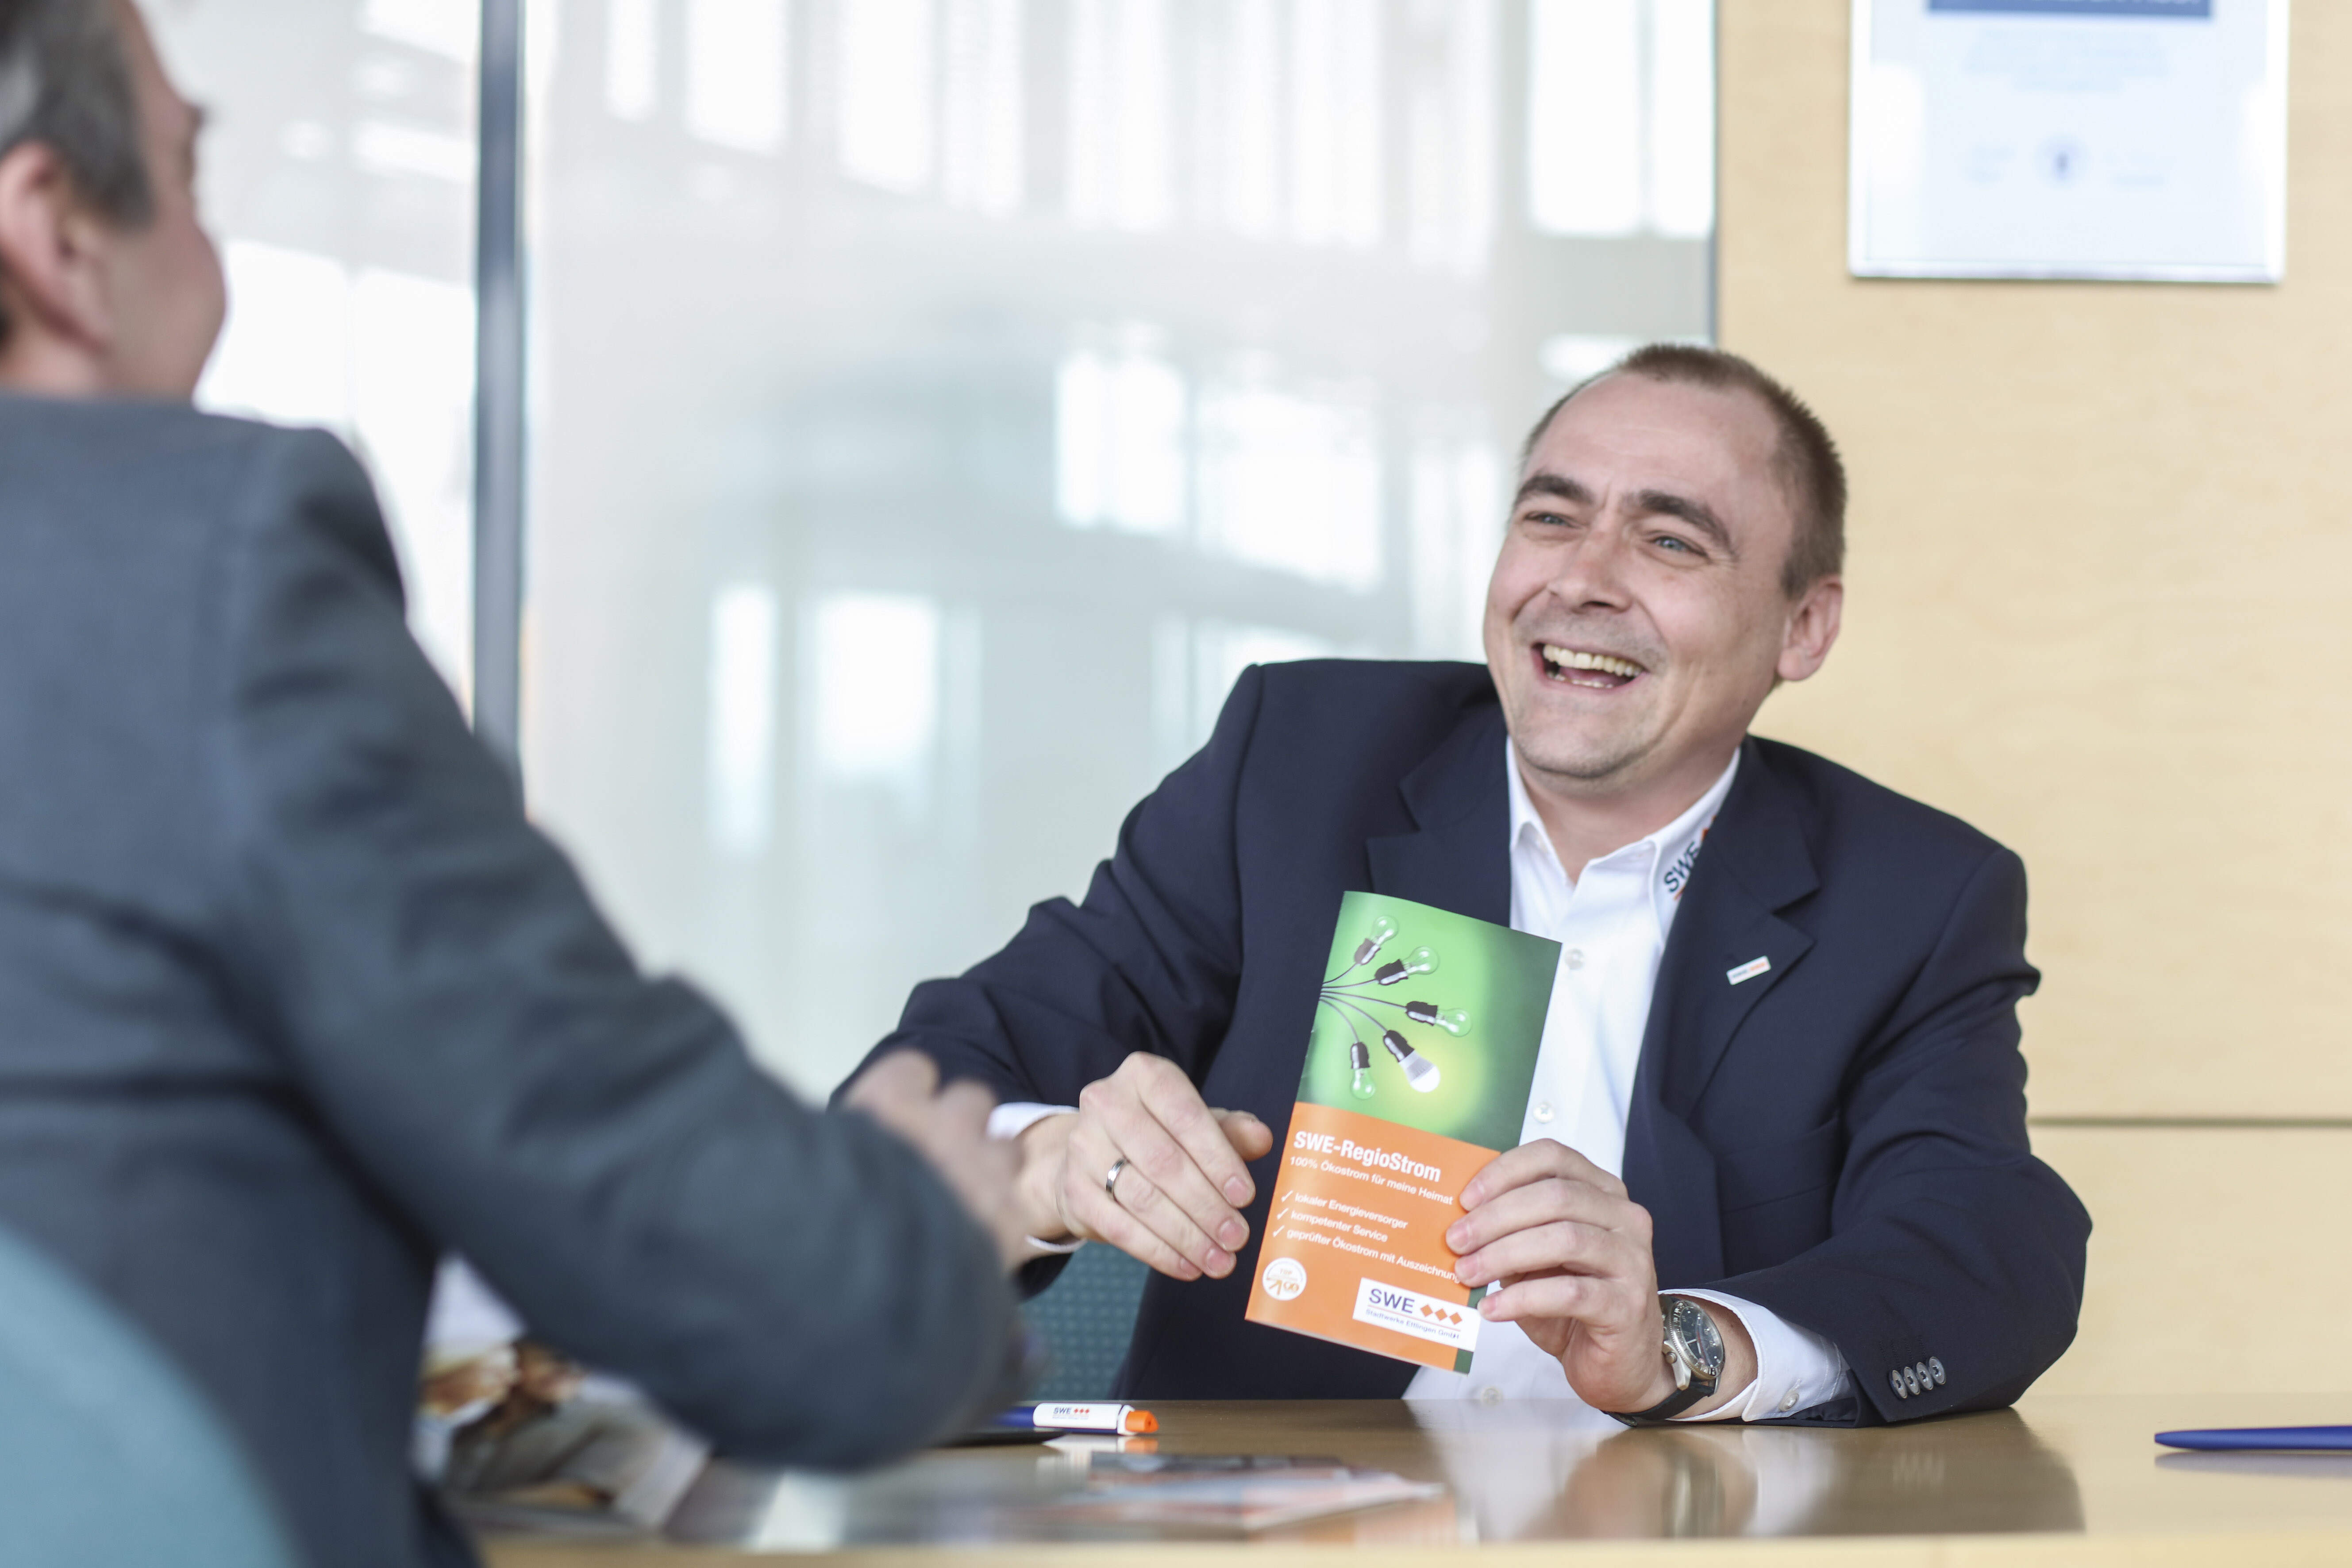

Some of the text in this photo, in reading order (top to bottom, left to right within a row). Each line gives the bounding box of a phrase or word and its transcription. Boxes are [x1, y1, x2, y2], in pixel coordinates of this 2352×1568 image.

[1293, 1130, 1441, 1182] SWE-RegioStrom
[1290, 1156, 1453, 1205] 100% Ökostrom für meine Heimat
[1291, 1210, 1388, 1243] kompetenter Service
[1295, 1193, 1409, 1229] lokaler Energieversorger
[1286, 1228, 1331, 1246] geprüfter
[1332, 1236, 1378, 1259] Ökostrom
[1380, 1252, 1395, 1264] mit
[1369, 1288, 1415, 1314] SWE
[1366, 1309, 1404, 1325] Stadtwerke
[1438, 1329, 1459, 1340] GmbH
